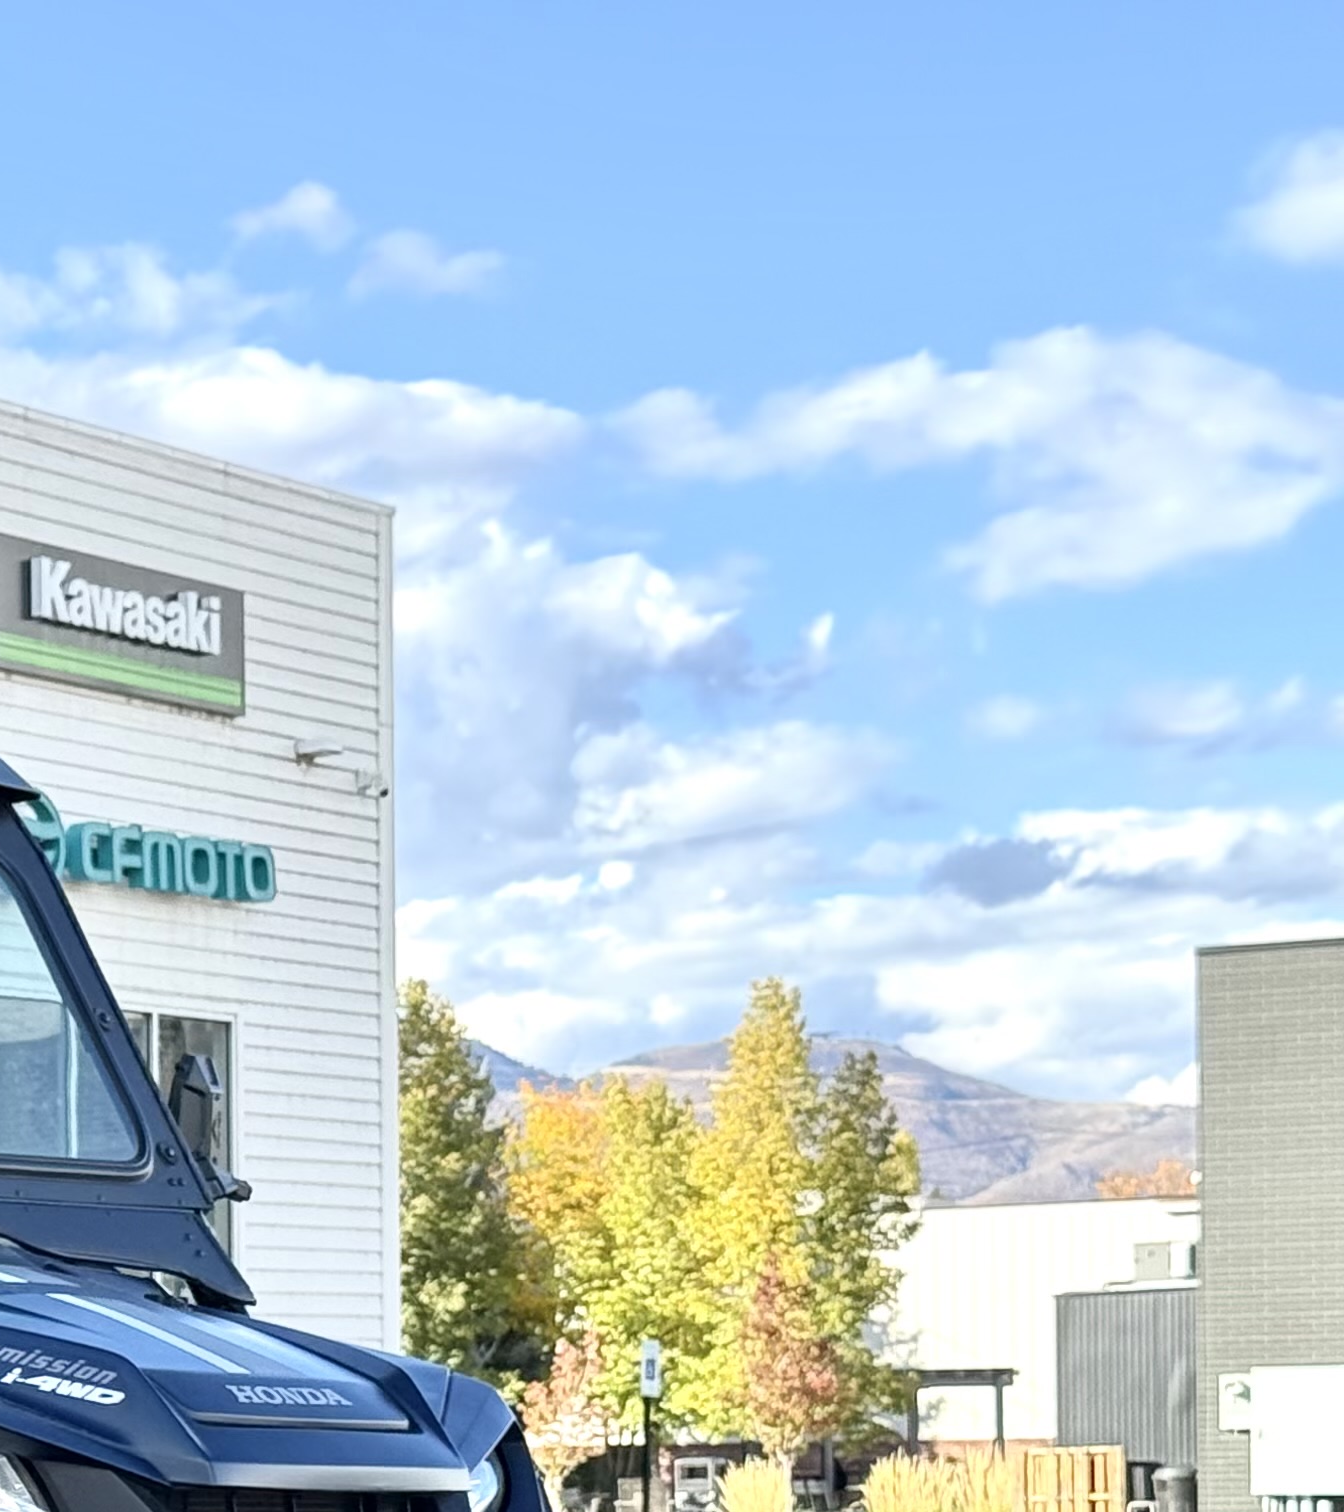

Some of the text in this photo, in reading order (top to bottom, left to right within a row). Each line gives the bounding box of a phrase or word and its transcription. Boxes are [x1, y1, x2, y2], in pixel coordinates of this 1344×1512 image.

[29, 555, 221, 656] Kawasaki
[68, 821, 278, 902] CFMOTO
[0, 1367, 127, 1405] i-4WD
[224, 1384, 354, 1407] HONDA
